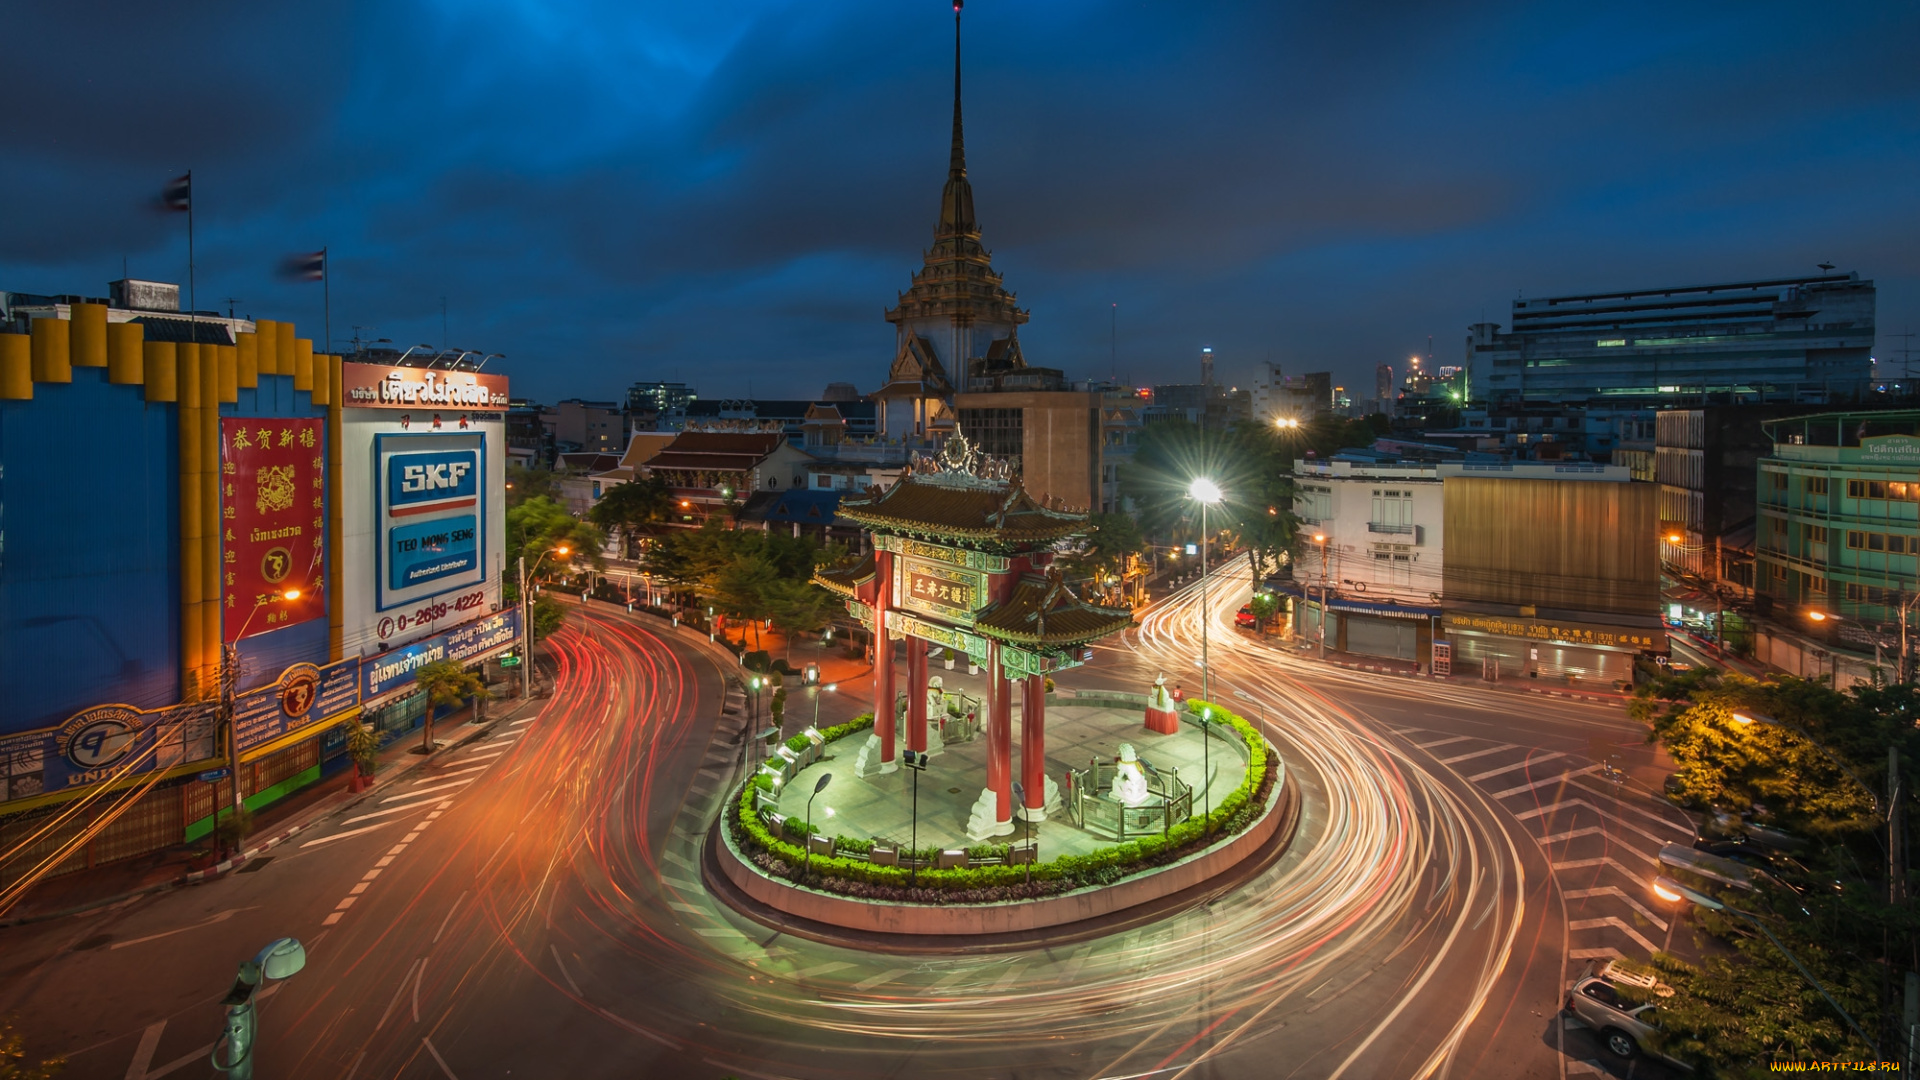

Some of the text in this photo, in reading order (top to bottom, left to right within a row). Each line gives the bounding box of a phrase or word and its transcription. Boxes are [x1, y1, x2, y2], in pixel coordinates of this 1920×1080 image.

[232, 426, 316, 451] 恭贺新禧
[402, 461, 471, 493] SKF
[397, 528, 474, 553] TEO MONG SENG
[397, 591, 484, 631] 0-2639-4222
[369, 644, 444, 694] ผู้แทนจำหน่าย
[68, 764, 133, 786] UNITY
